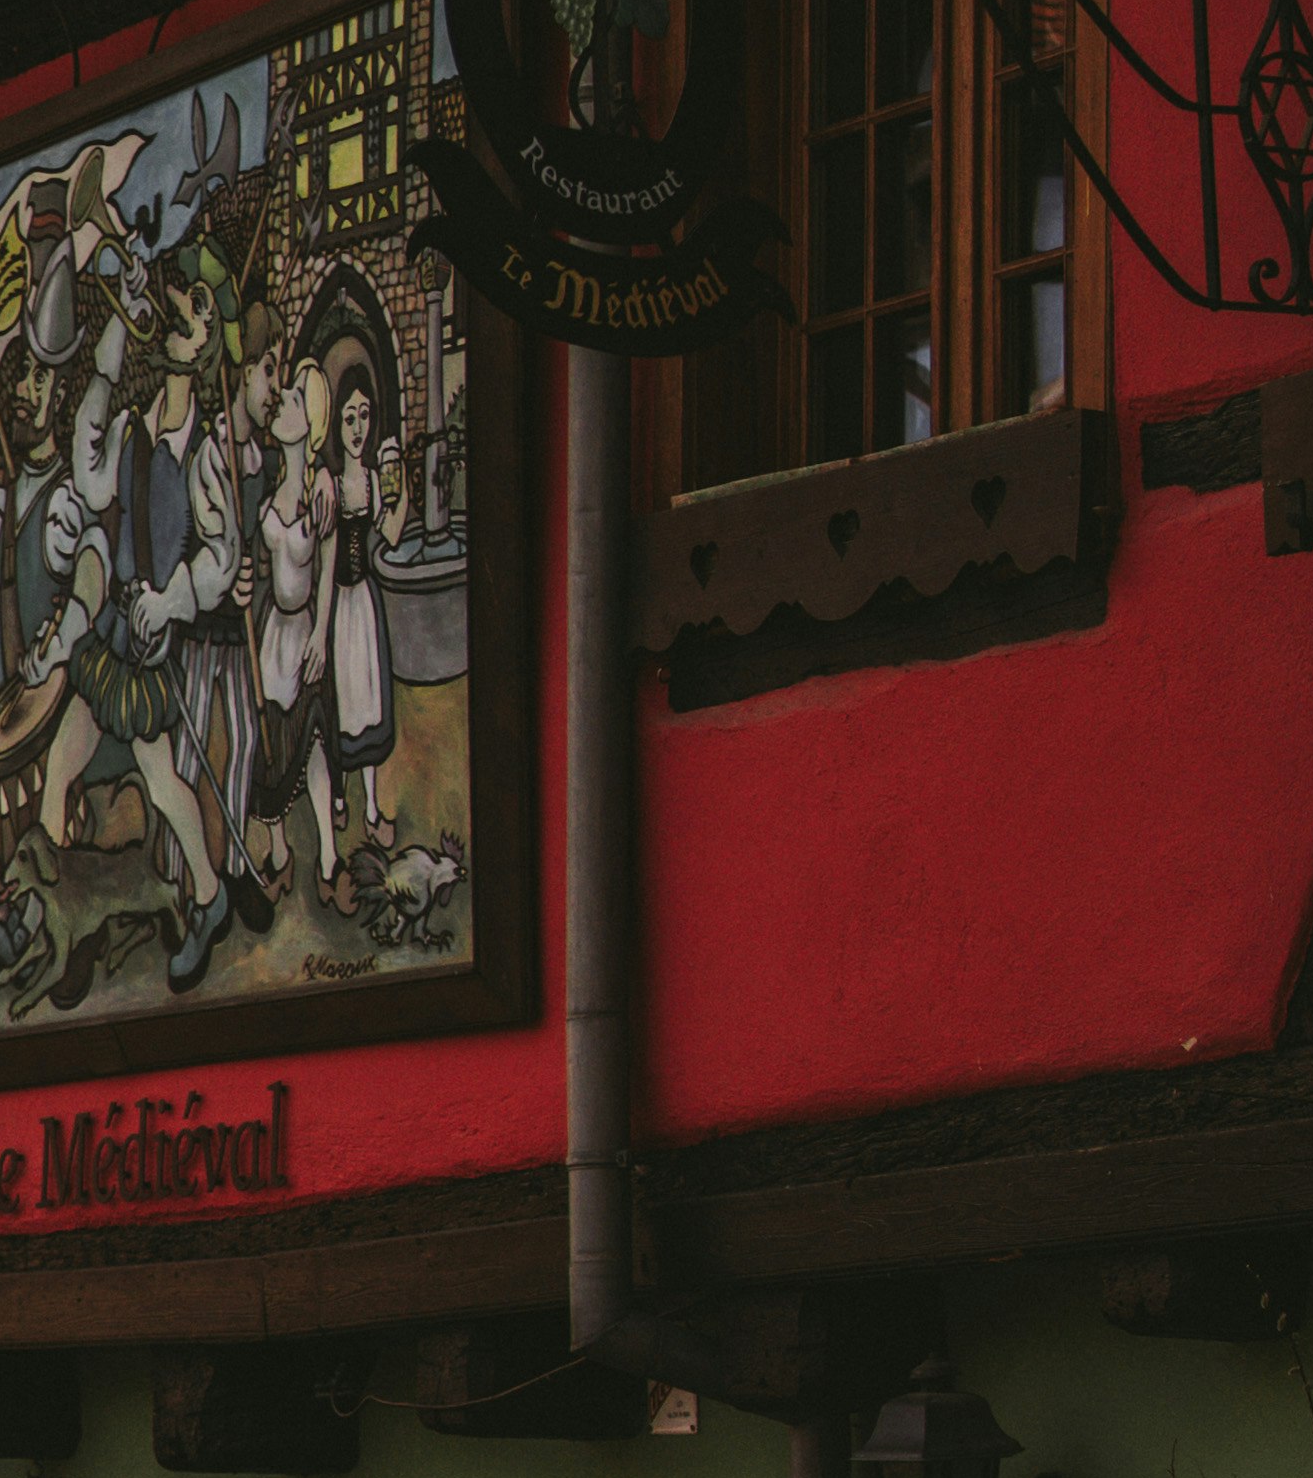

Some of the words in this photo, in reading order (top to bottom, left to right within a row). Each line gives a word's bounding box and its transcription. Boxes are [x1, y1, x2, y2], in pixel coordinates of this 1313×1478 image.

[519, 135, 684, 215] Restaurant
[500, 243, 534, 291] Le
[543, 256, 731, 329] Médiéval
[36, 1080, 289, 1210] Médiéval
